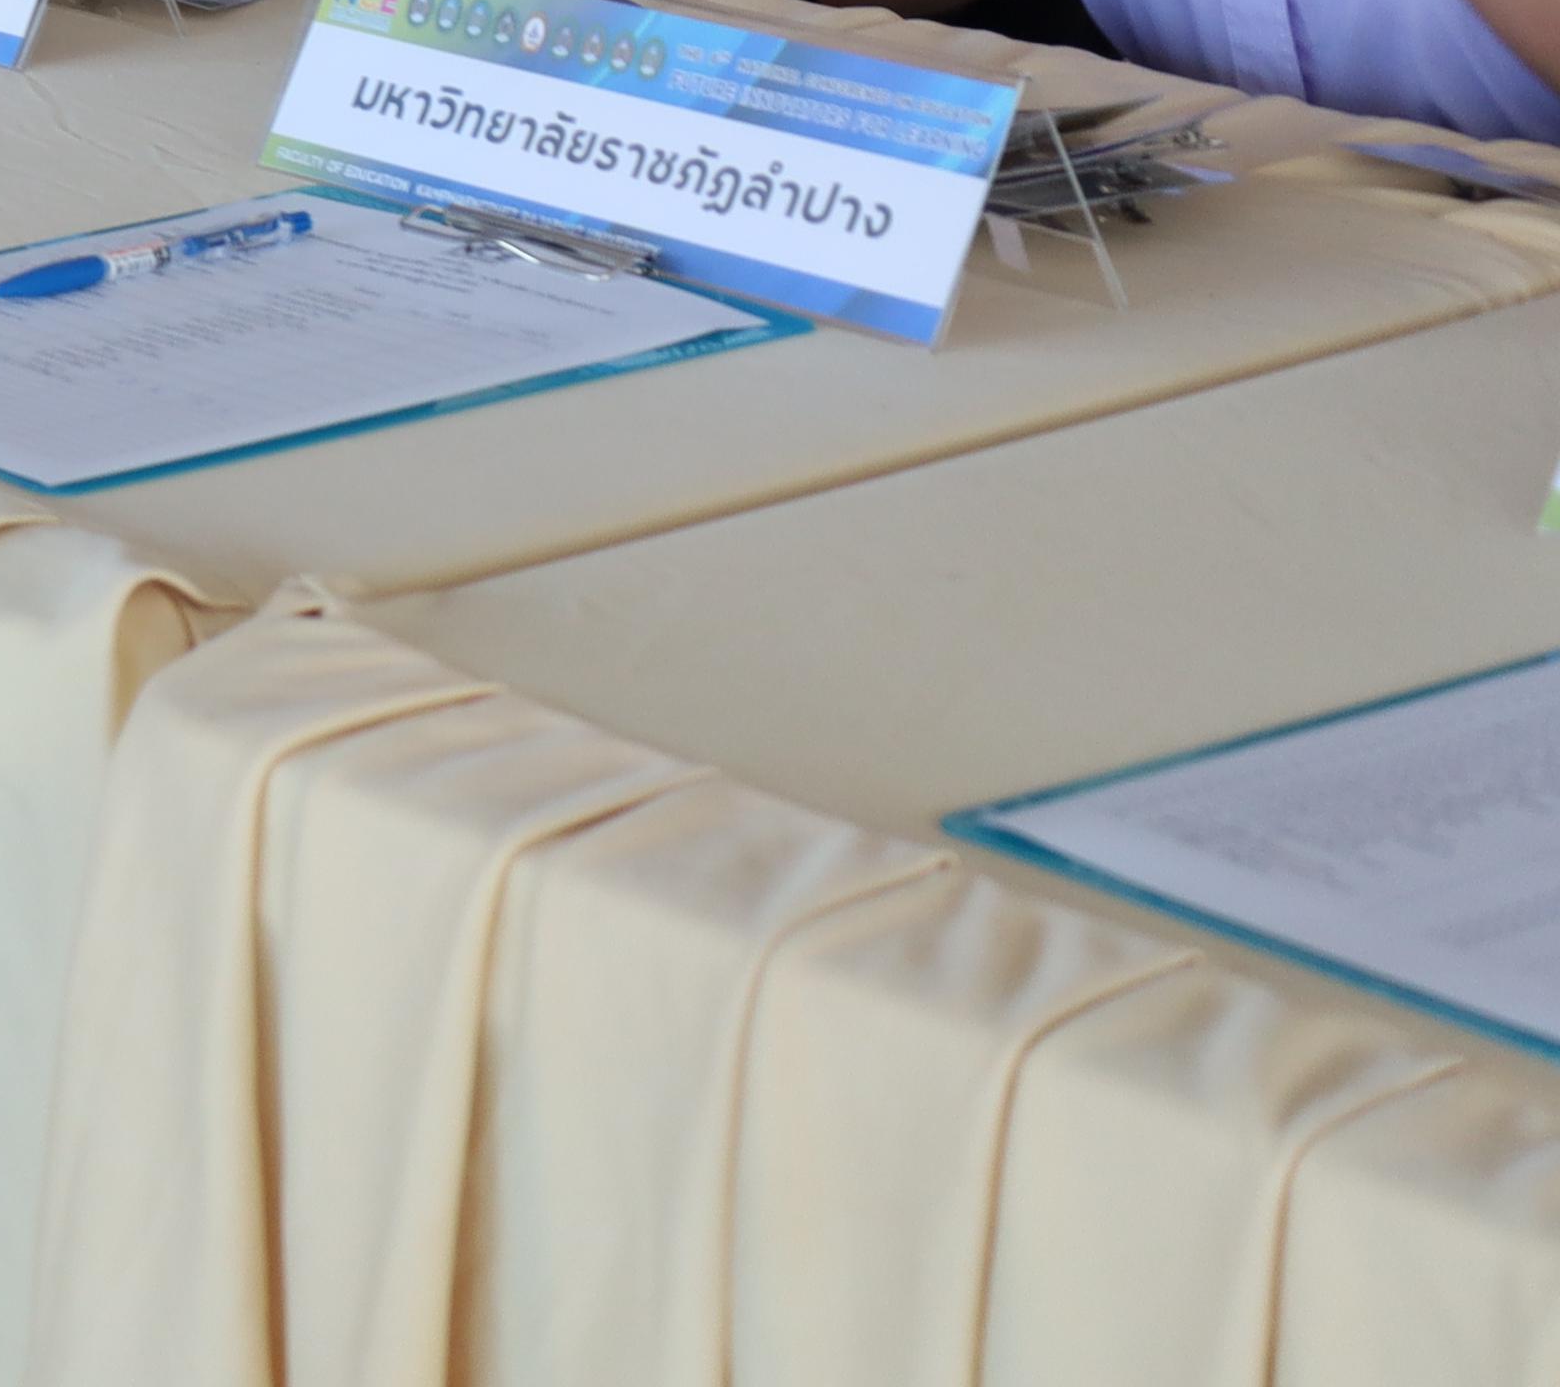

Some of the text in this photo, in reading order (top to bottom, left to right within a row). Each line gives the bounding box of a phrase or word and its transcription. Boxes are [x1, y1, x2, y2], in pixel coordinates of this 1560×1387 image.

[351, 71, 894, 240] มหาวิทยาลัยราชภัฏลำปาง
